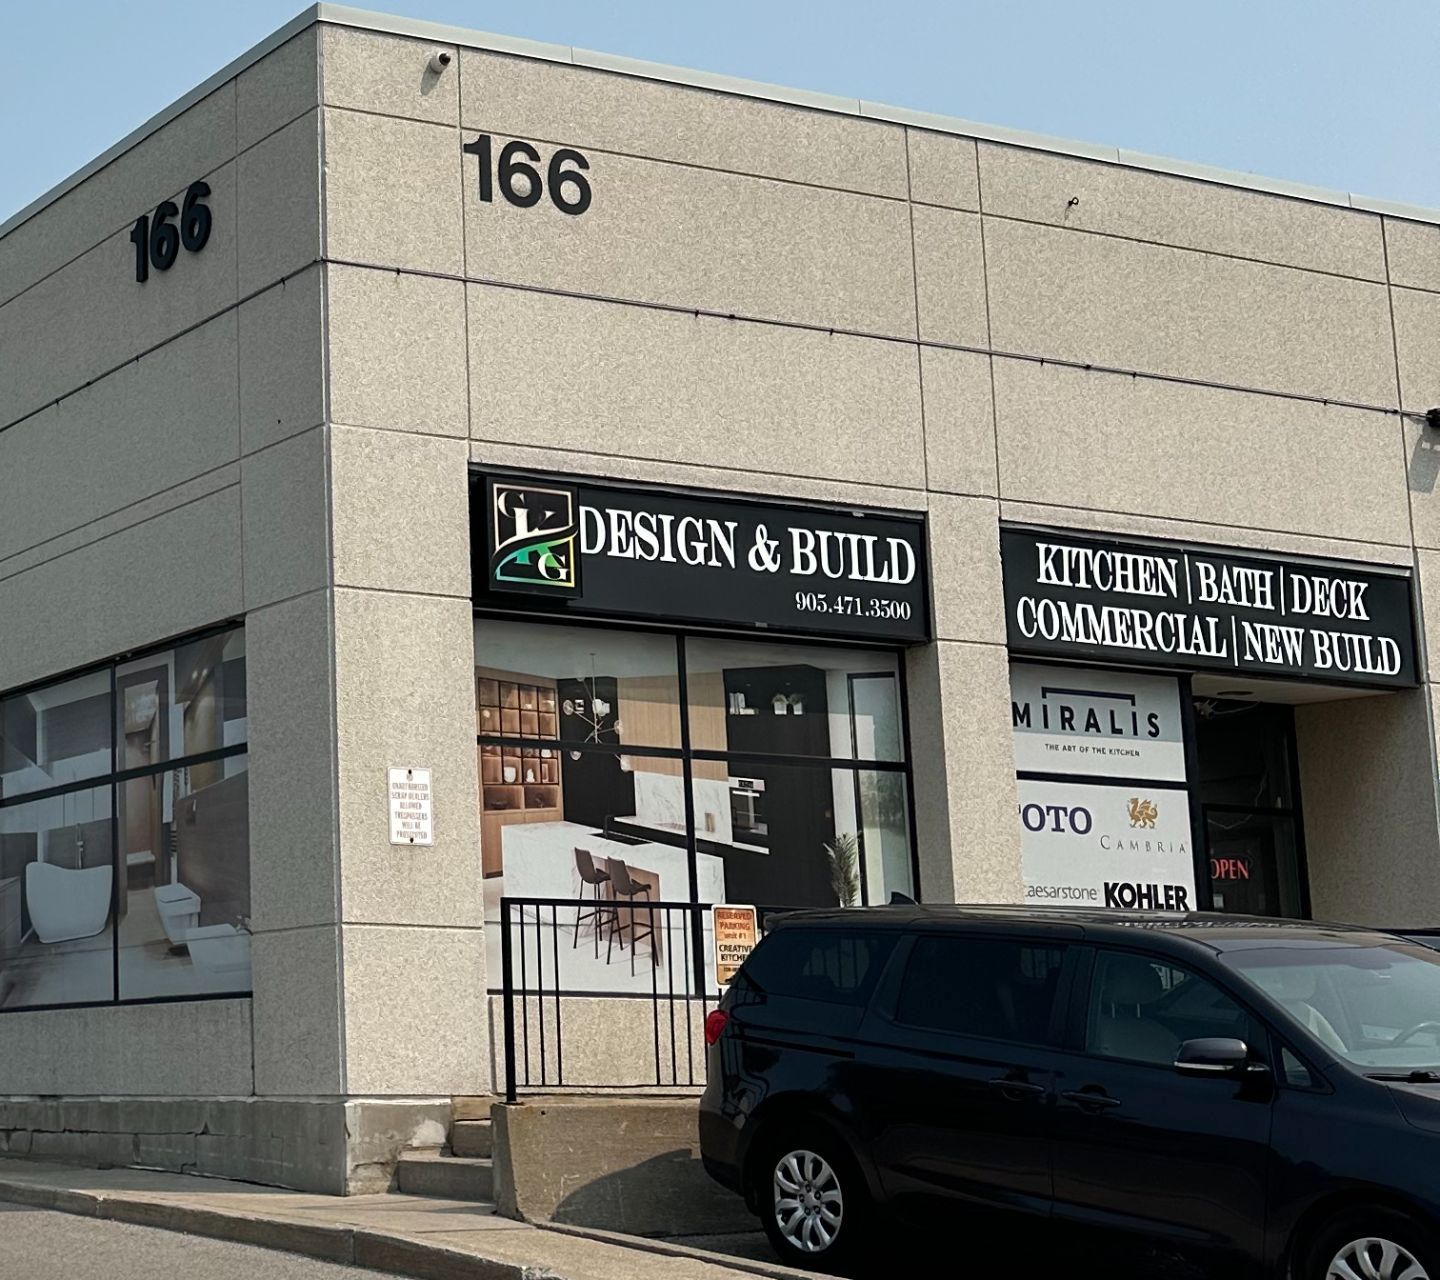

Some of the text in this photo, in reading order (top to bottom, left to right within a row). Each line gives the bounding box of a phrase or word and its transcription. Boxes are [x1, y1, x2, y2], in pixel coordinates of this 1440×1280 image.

[463, 134, 592, 216] 166
[130, 181, 213, 283] 166
[578, 505, 916, 585] DESIGN & BUILD
[1035, 542, 1370, 621] KITCHEN BATH DECK
[795, 591, 912, 620] 905.471.3500
[1016, 596, 1401, 676] COMMERCIAL NEW BUILD
[1011, 701, 1161, 738] MIRALIS
[1045, 743, 1060, 751] THE
[1062, 745, 1077, 753] ART
[1092, 747, 1107, 755] THE
[1109, 748, 1141, 757] KITCHEN
[1018, 803, 1093, 835] OTO
[1100, 835, 1187, 854] CAMBRIA
[1103, 881, 1191, 911] KOHLER
[717, 911, 752, 920] RESERVED
[720, 921, 751, 930] PARKING
